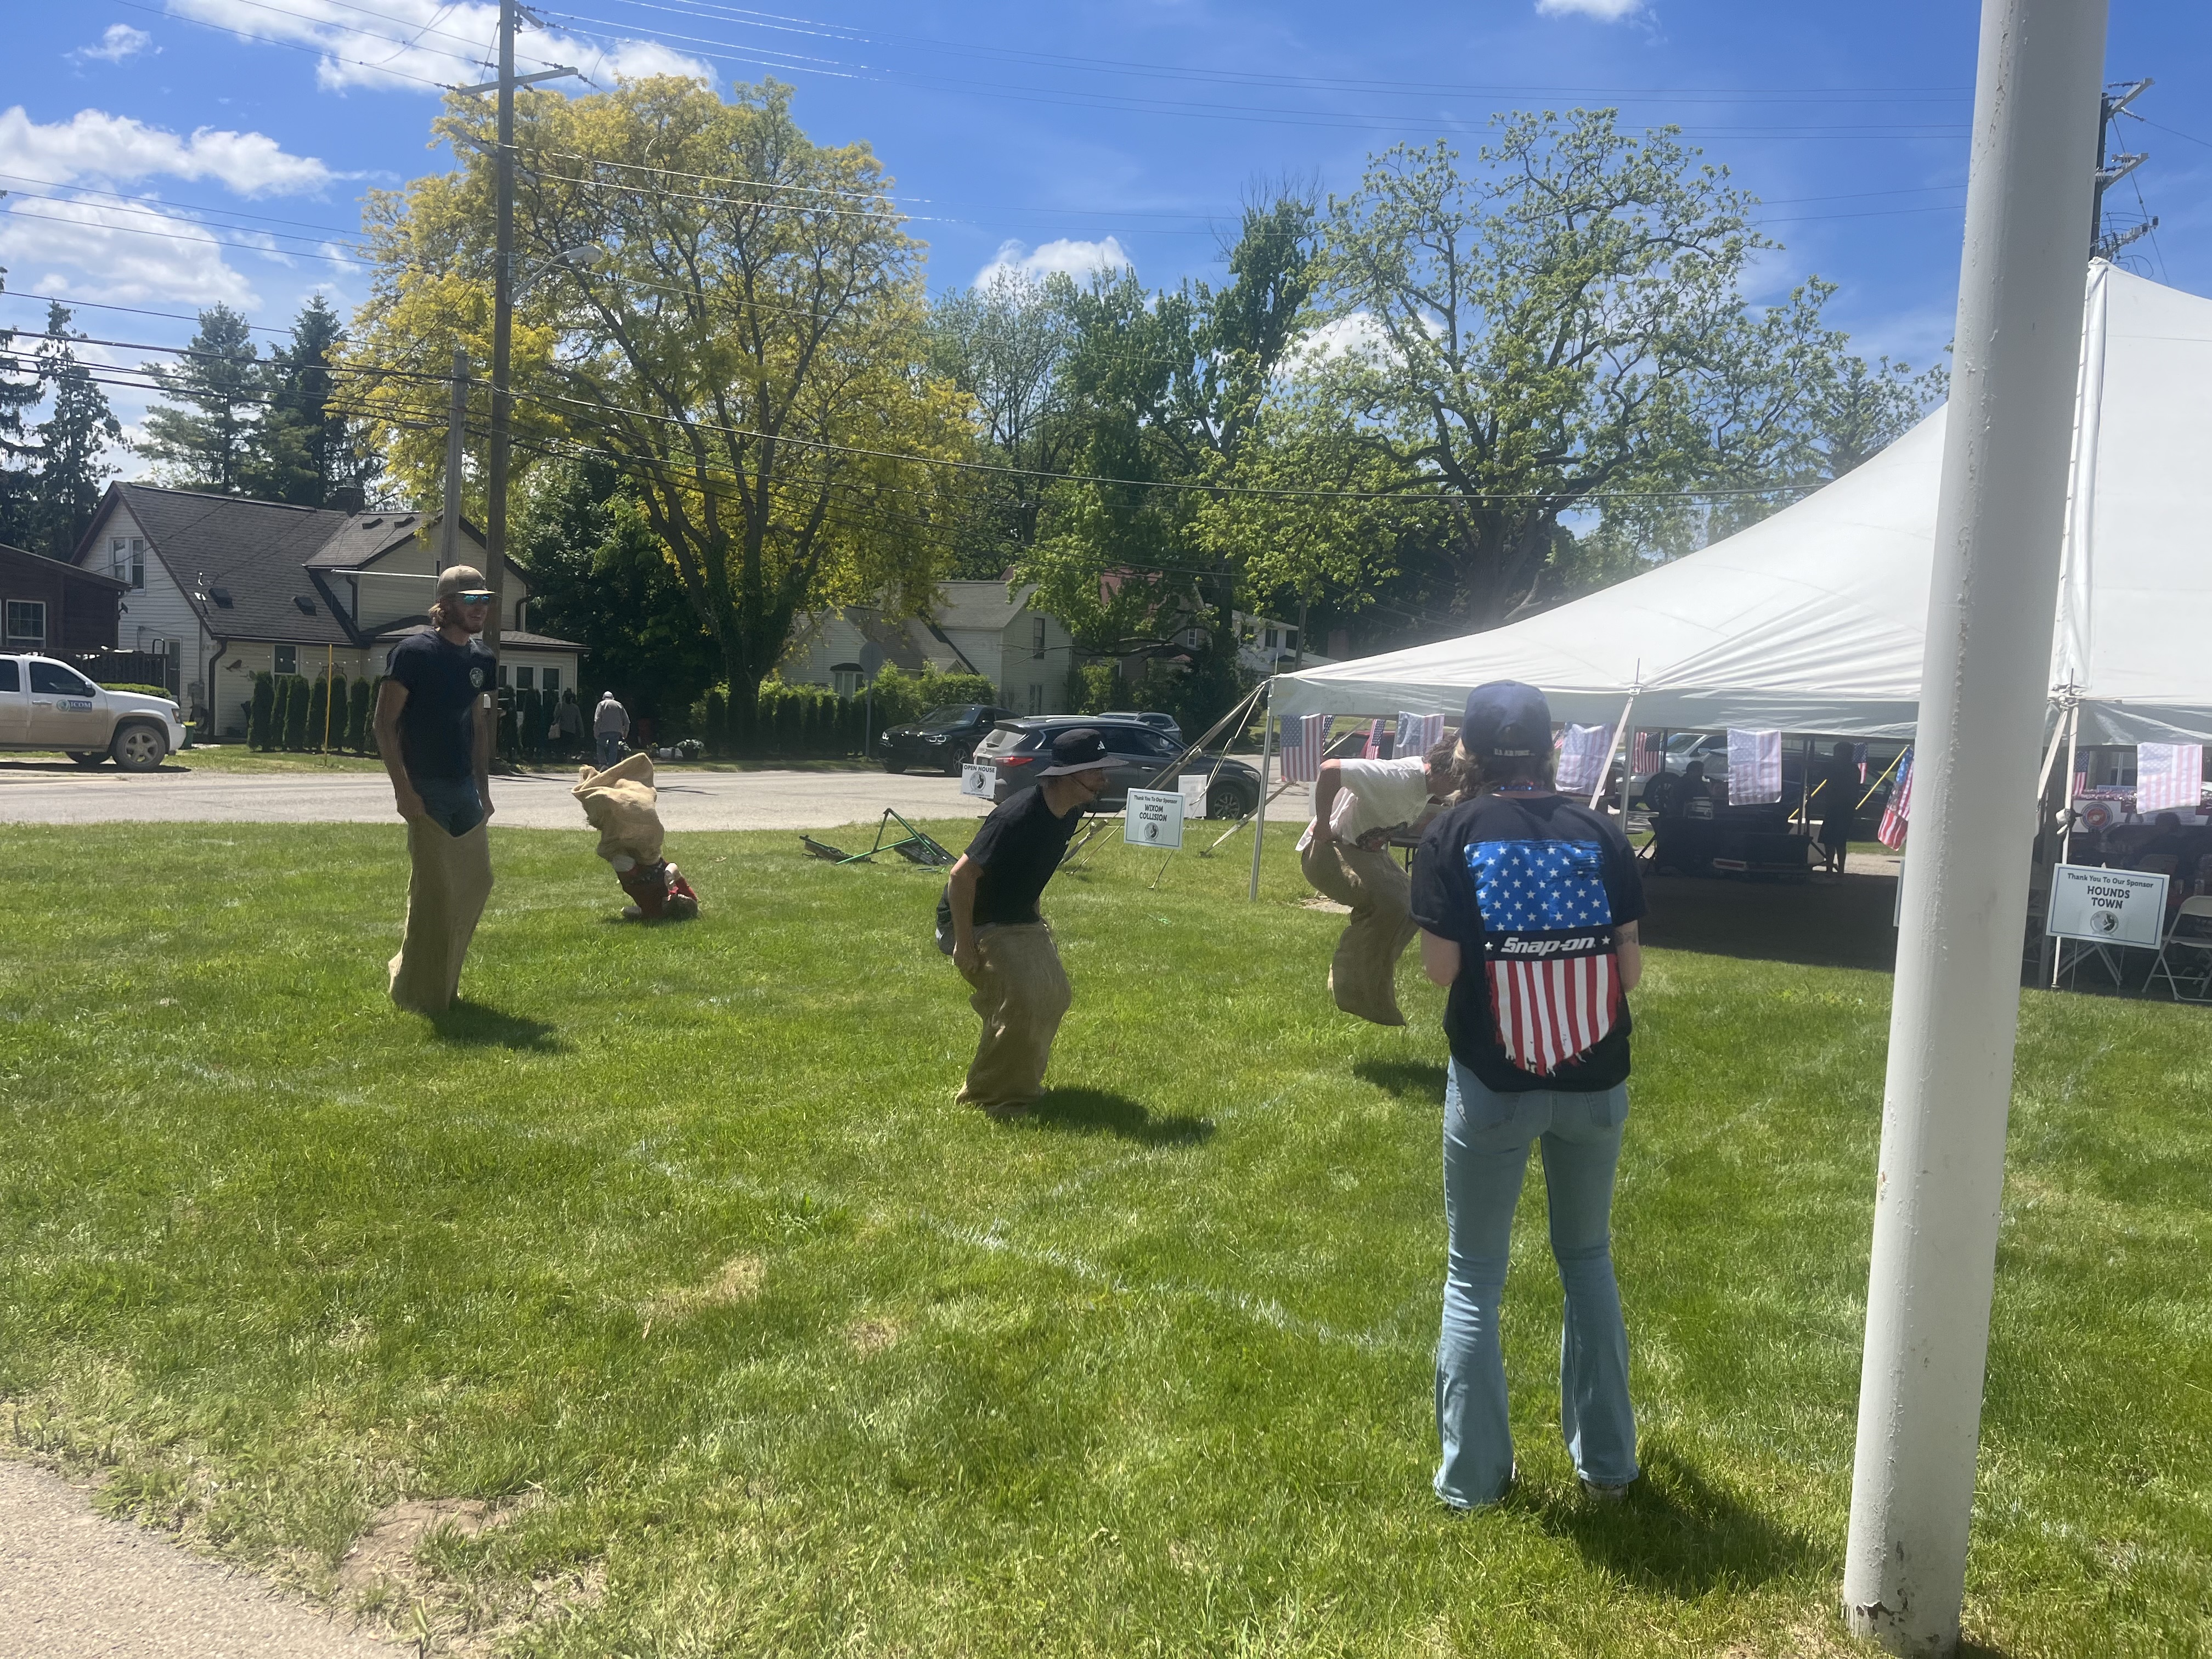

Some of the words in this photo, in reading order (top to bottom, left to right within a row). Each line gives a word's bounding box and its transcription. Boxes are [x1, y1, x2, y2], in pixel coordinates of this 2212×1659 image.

[1144, 804, 1164, 812] WIXOM
[1139, 812, 1167, 822] COLLISION
[2067, 873, 2088, 881] Thank
[2126, 879, 2154, 888] Sponsor
[2087, 885, 2130, 899] HOUNDS
[2091, 897, 2124, 909] TOWN
[1500, 936, 1594, 957] Snap-on
